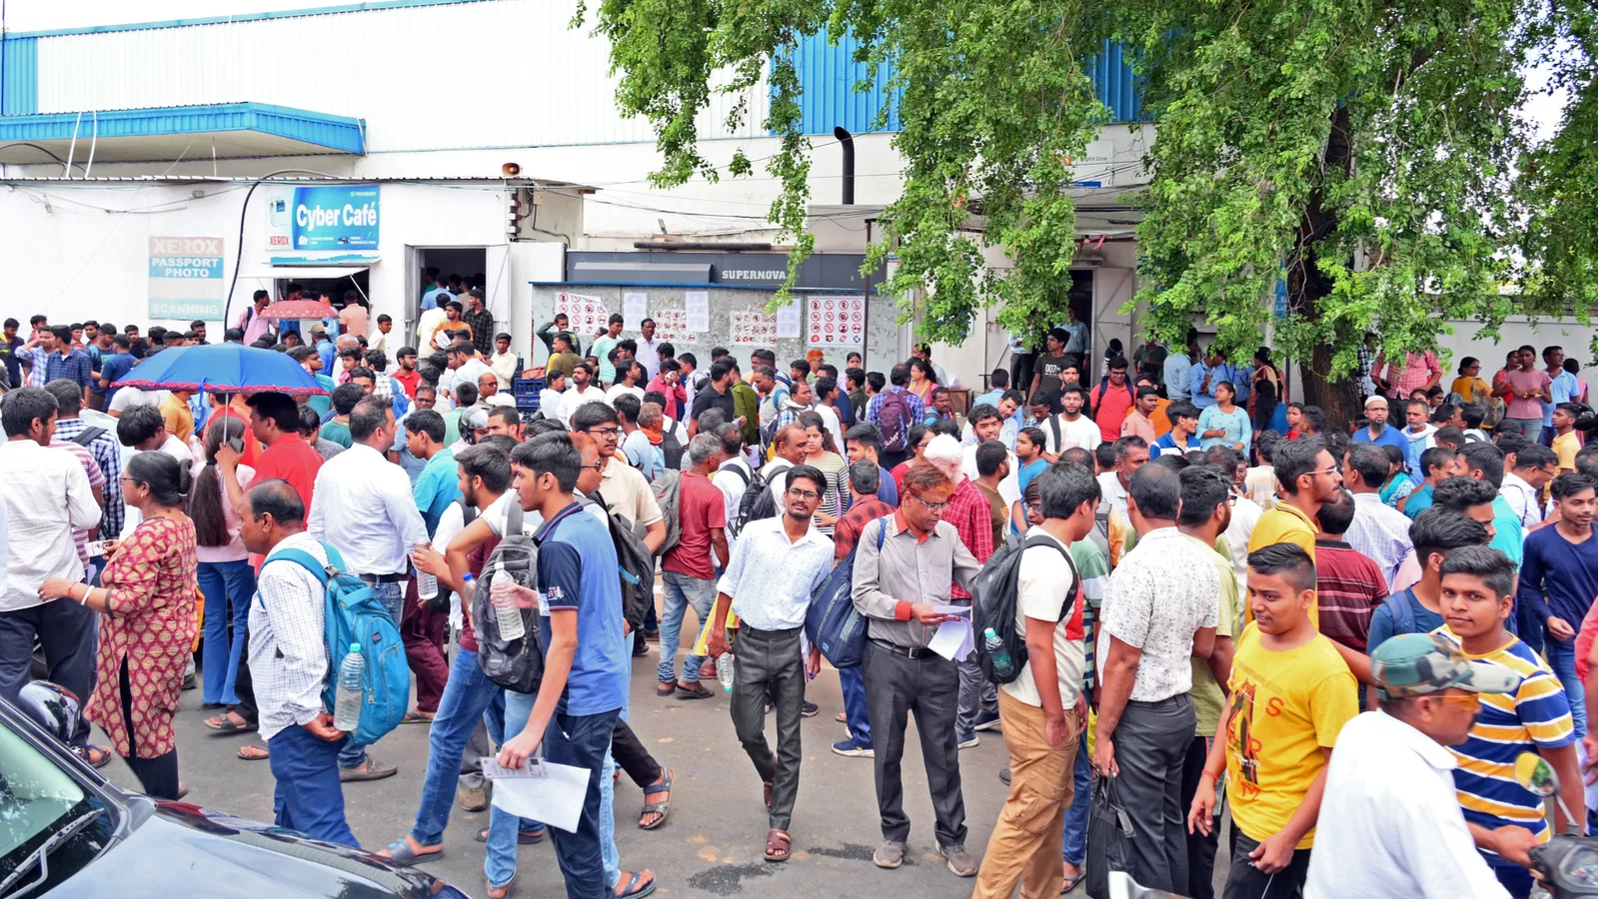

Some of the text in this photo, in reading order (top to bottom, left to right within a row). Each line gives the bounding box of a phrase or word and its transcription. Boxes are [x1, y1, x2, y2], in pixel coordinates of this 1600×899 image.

[296, 201, 377, 231] Cyber Café
[269, 236, 289, 245] XEROX
[152, 239, 218, 254] XEROX
[152, 257, 219, 267] PASSPORT
[165, 268, 209, 278] PHOTO
[722, 270, 786, 280] SUPERNOVA
[152, 304, 218, 315] SCANNING
[1265, 696, 1284, 717] S
